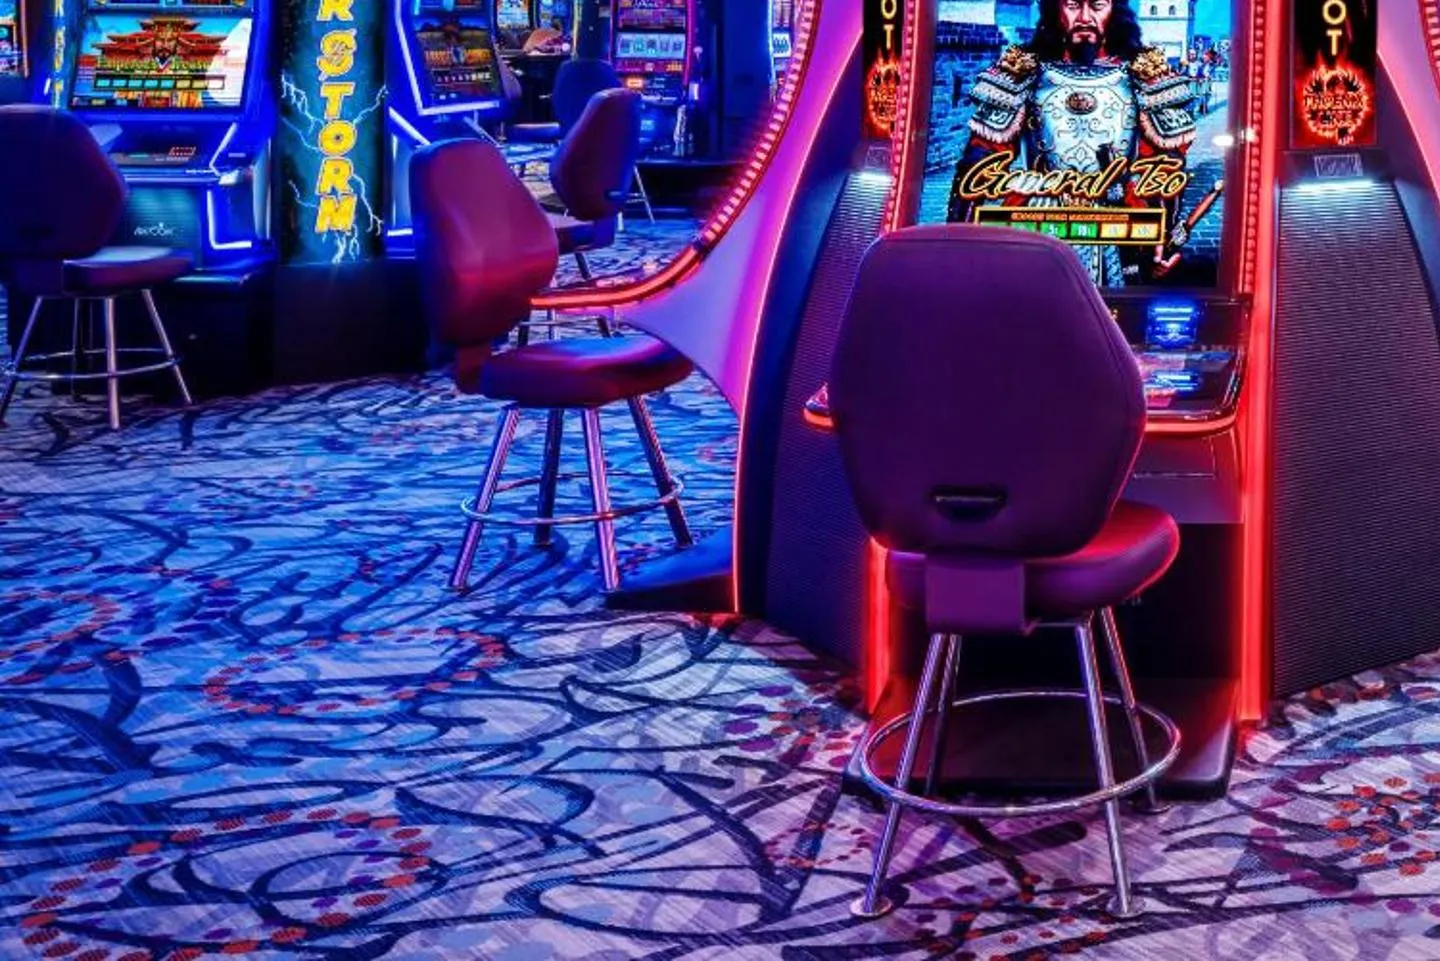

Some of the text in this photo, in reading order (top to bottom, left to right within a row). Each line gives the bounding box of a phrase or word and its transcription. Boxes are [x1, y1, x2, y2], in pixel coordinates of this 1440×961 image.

[315, 28, 357, 234] STORM
[960, 150, 1189, 199] General Tso
